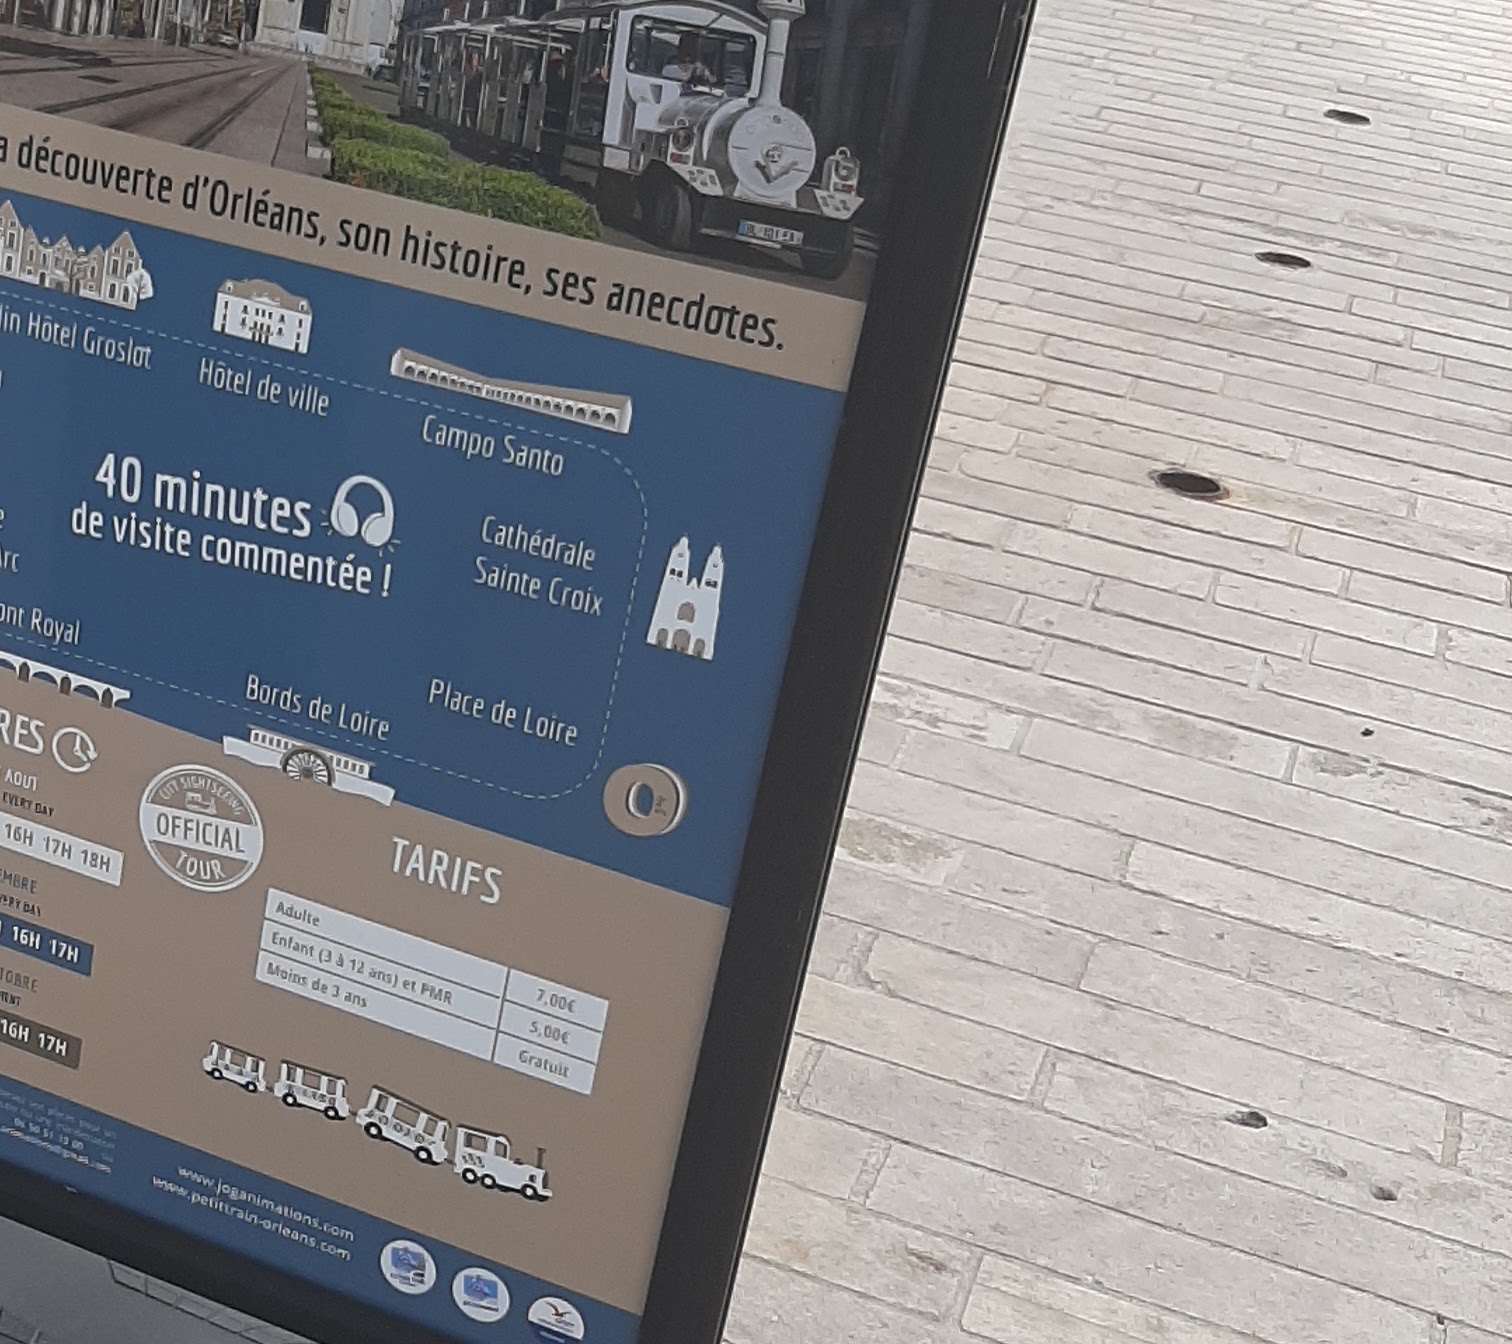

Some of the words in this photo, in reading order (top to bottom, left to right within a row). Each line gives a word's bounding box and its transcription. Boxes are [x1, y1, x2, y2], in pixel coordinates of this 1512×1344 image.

[17, 134, 173, 204] découverte
[338, 218, 391, 257] son
[400, 224, 532, 295] histoire,
[542, 267, 597, 306] ses
[606, 282, 784, 351] anecdotes.
[27, 311, 77, 348] Hôtel
[83, 326, 152, 370] Groslot
[199, 357, 252, 396] Hôtel
[257, 373, 281, 404] de
[288, 383, 329, 416] ville
[422, 414, 495, 460] Campo
[502, 434, 564, 476] Santo
[95, 453, 142, 503] 40
[154, 470, 313, 559] minutes
[71, 501, 104, 538] de
[113, 511, 191, 557] visite
[201, 504, 372, 594] commentée
[482, 515, 595, 571] Cathédrale
[474, 556, 541, 599] Sainte
[548, 577, 603, 616] Croix
[30, 607, 80, 645] Royal
[246, 674, 302, 713] Bords
[308, 696, 333, 724] de
[338, 703, 389, 741] Loire
[429, 678, 484, 718] Place
[491, 699, 517, 728] de
[523, 706, 577, 746] Loire
[4, 823, 34, 847] 16H
[45, 835, 72, 860] 17H
[80, 849, 111, 873] 18H
[155, 811, 246, 854] OFFICIAL
[175, 854, 227, 882] TOUR
[392, 836, 502, 904] TARIFS
[12, 926, 41, 950] 16H
[51, 939, 79, 963] 17H
[275, 901, 320, 927] Adulte
[271, 931, 315, 957] Enfant
[349, 958, 365, 975] 12
[368, 967, 399, 989] ans)
[402, 976, 418, 994] et
[420, 982, 452, 1005] PMR
[0, 1018, 30, 1043] 16H
[38, 1032, 67, 1057] 17H
[266, 962, 308, 987] Moins
[311, 977, 329, 995] de
[331, 984, 340, 998] 3
[343, 991, 367, 1008] ans
[518, 1049, 570, 1078] Gratuit
[152, 1175, 351, 1261] www.petittrain-orleans.com
[178, 1168, 354, 1242] www.joganimations.com
